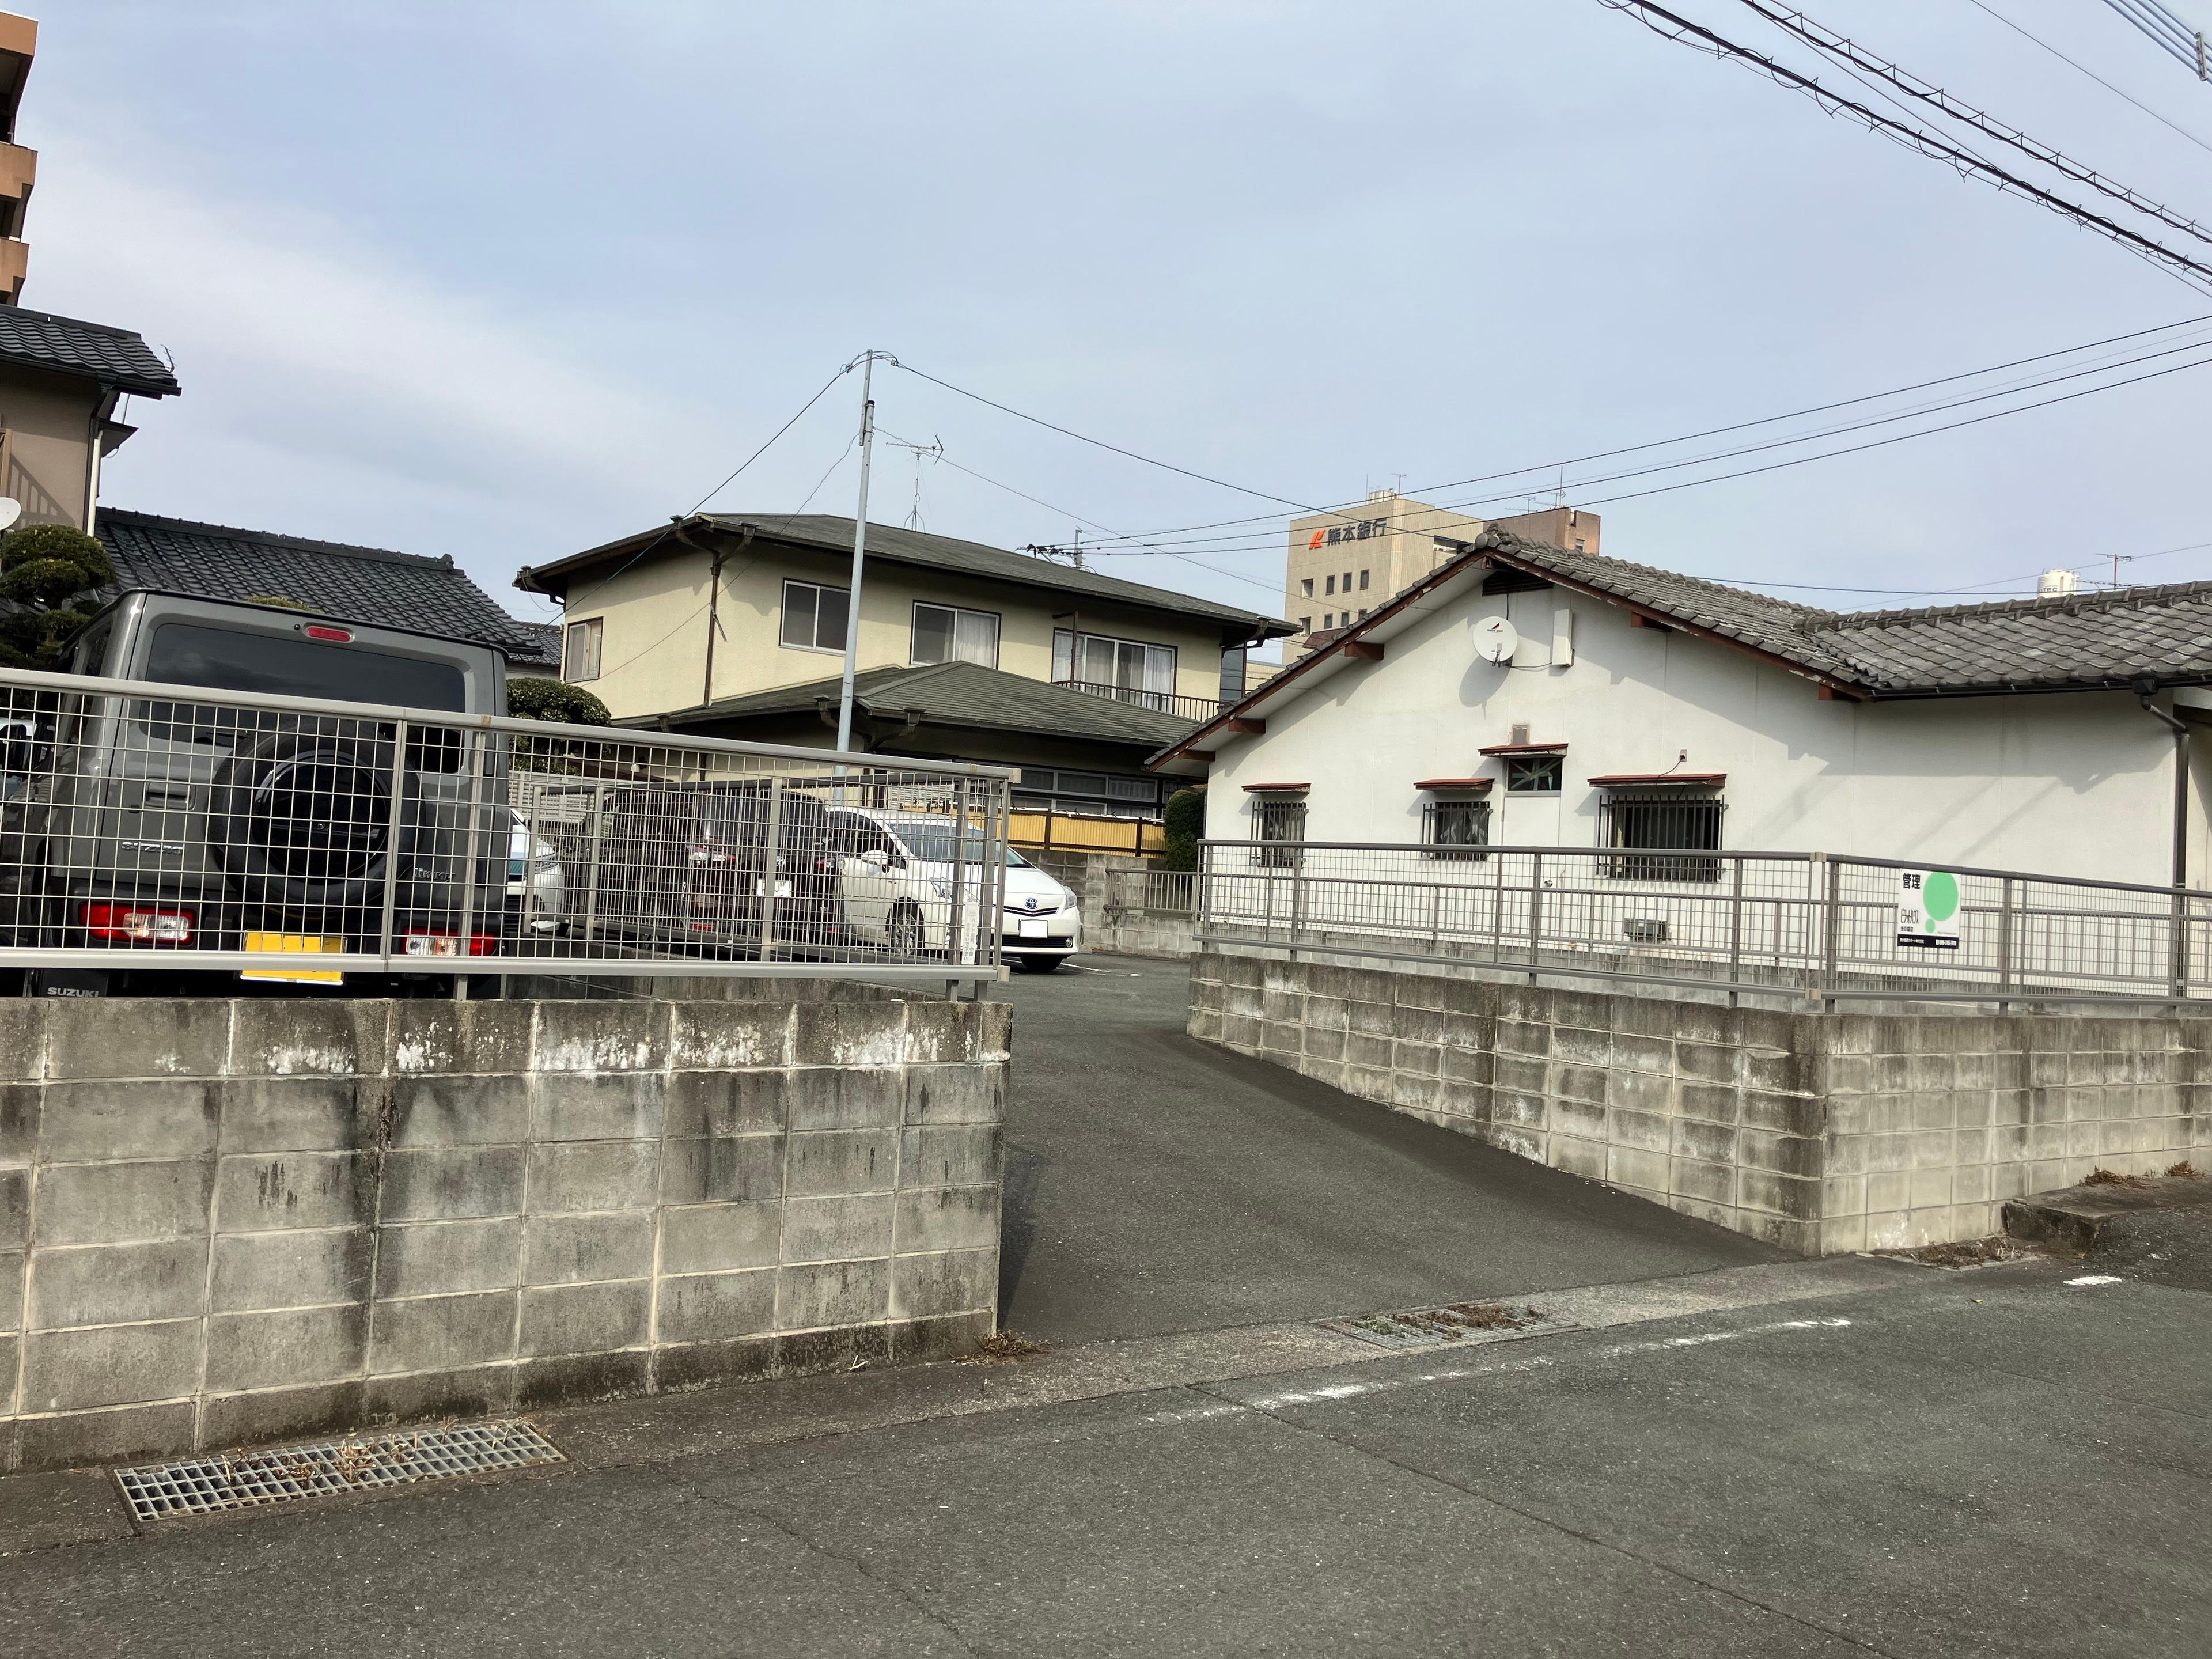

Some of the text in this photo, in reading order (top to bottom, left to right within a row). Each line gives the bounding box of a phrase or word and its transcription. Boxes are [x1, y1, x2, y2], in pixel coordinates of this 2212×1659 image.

[1328, 517, 1387, 546] 熊本銀行
[1903, 872, 1921, 889] 管理
[47, 987, 99, 998] SUZUKI
